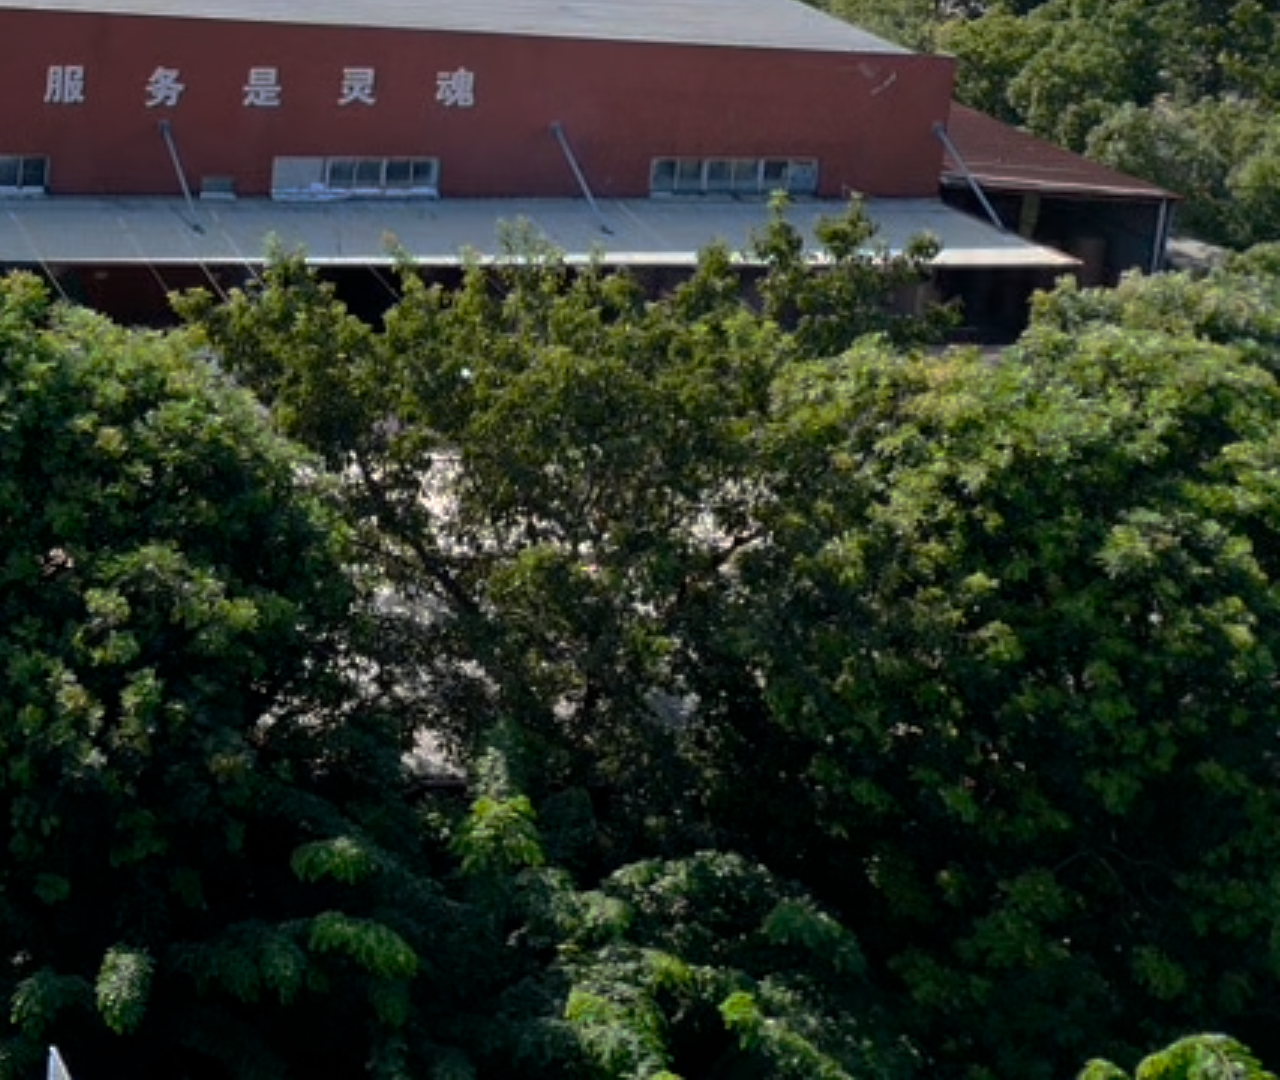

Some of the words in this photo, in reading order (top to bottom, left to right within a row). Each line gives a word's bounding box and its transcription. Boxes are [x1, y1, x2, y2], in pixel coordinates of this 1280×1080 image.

[43, 65, 475, 107] 服务是灵魂
